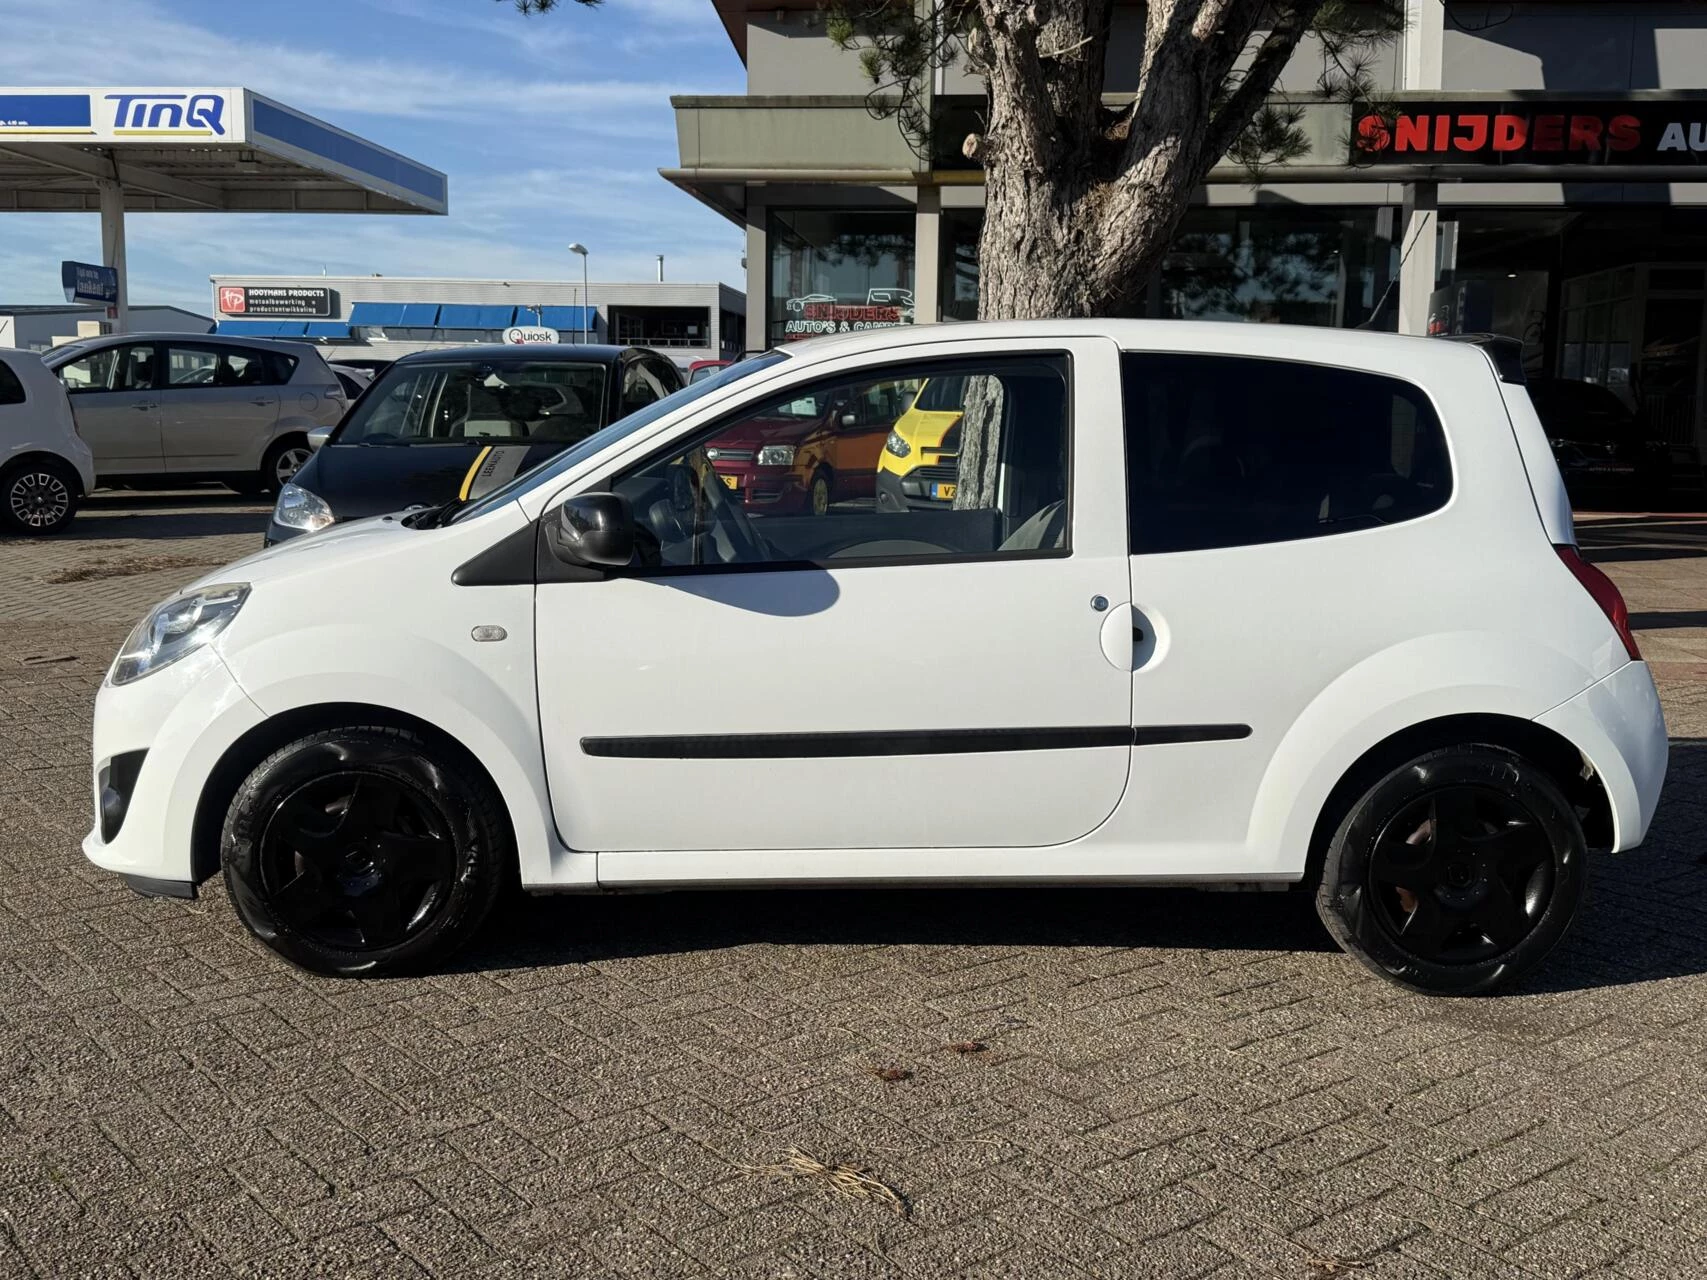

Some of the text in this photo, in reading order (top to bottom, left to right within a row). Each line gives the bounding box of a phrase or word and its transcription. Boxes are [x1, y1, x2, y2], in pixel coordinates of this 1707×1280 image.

[1356, 114, 1642, 152] SNIJDERS
[248, 289, 325, 297] HOOYMANS PRODUCTS
[785, 321, 836, 334] AUTO'S
[509, 329, 552, 344] Quiosk
